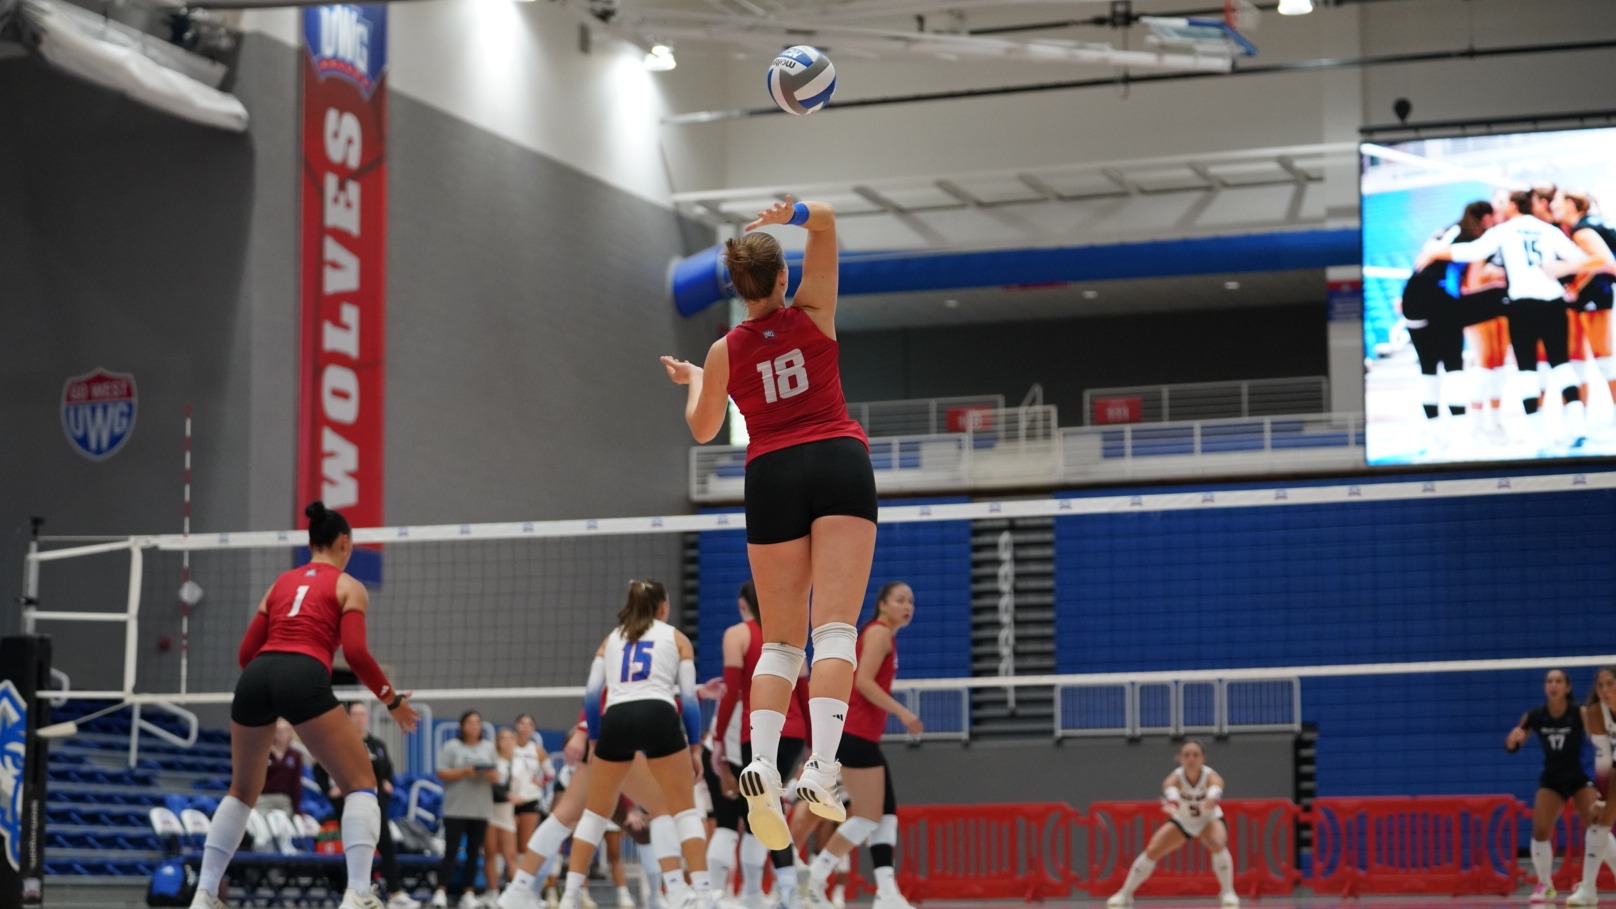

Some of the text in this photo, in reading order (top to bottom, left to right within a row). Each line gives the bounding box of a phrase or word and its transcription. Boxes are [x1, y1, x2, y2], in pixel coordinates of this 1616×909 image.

[321, 106, 362, 510] WOLVES
[91, 379, 128, 398] WEST
[756, 348, 809, 404] 18
[68, 401, 129, 451] UWG
[287, 585, 310, 617] 1
[620, 640, 655, 683] 15
[1548, 734, 1566, 751] 17
